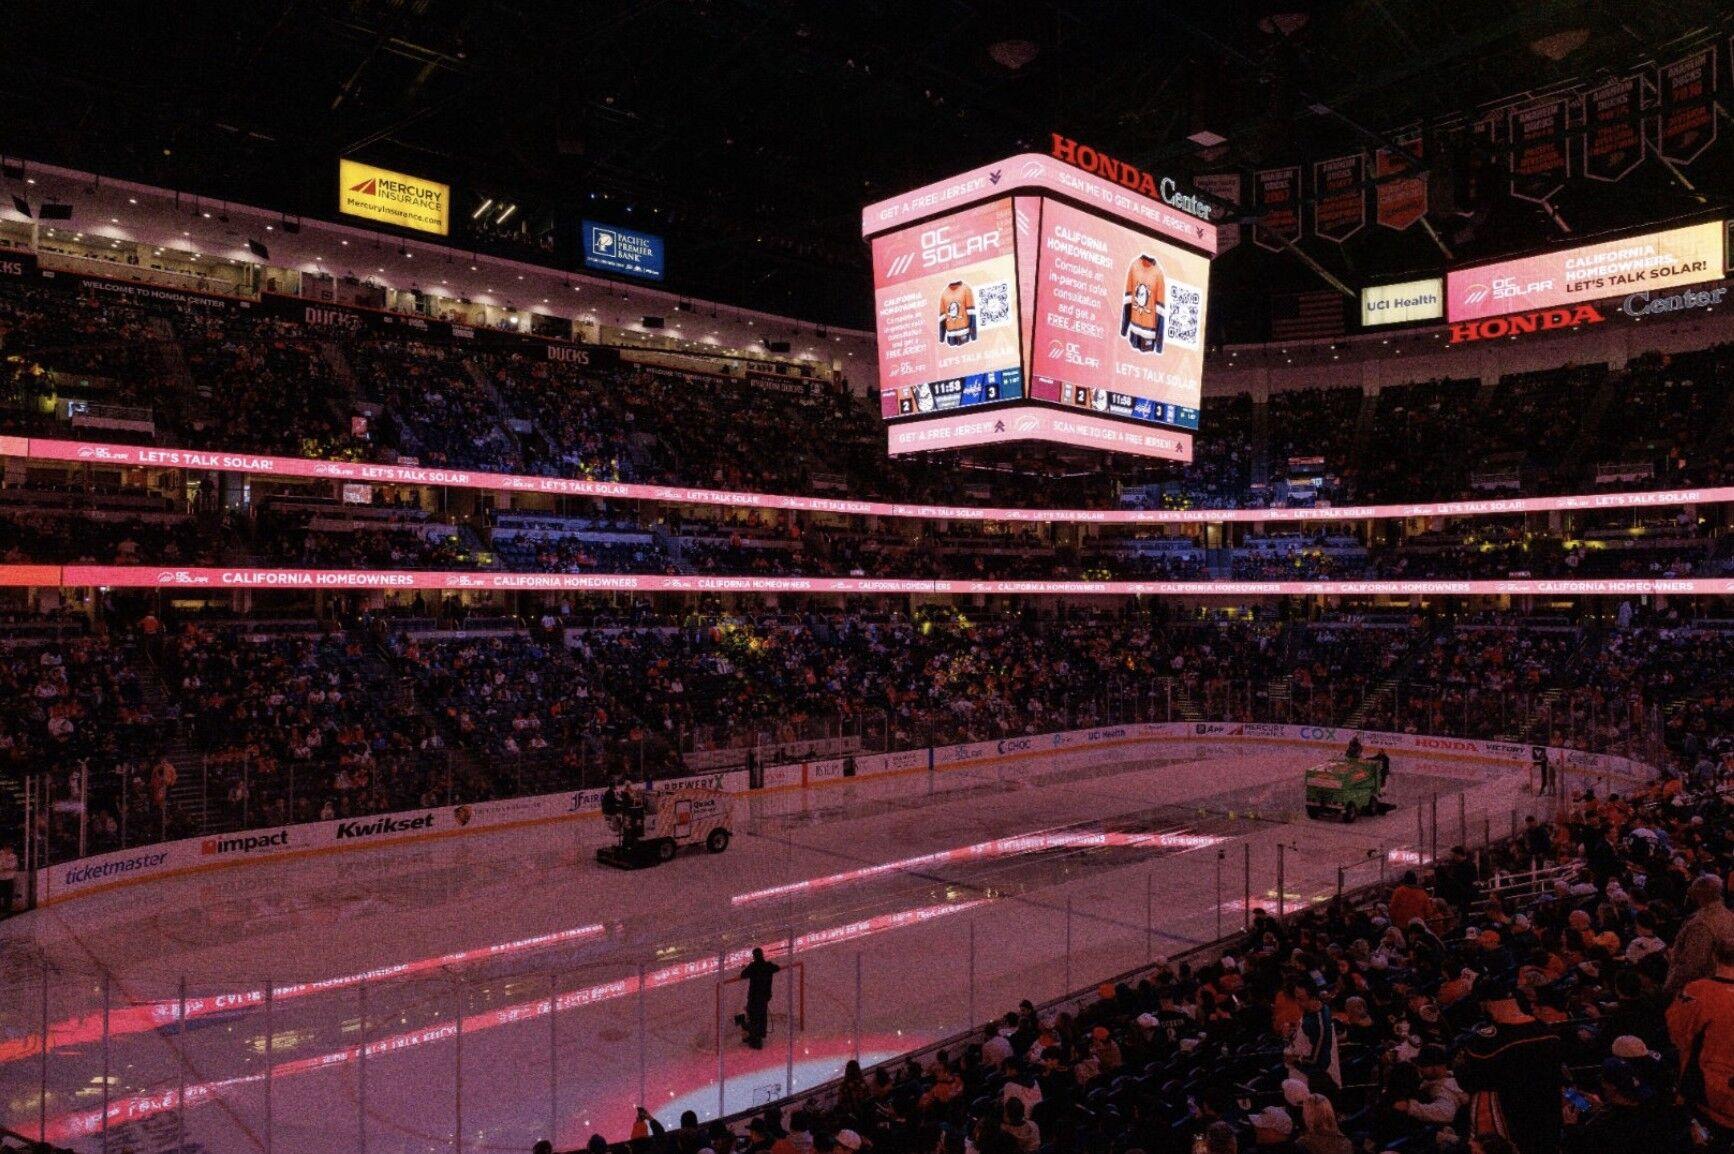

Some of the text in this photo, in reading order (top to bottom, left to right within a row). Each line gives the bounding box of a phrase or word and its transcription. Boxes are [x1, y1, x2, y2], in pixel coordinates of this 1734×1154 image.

[1052, 132, 1160, 200] HONDA
[1160, 177, 1212, 220] Center
[378, 178, 442, 202] MERCURY
[1058, 171, 1084, 191] SCAN
[1085, 180, 1101, 196] ME
[1101, 187, 1114, 202] TO
[1114, 194, 1131, 211] GET
[1131, 203, 1139, 214] A
[1140, 204, 1161, 222] FREE
[378, 188, 441, 212] INSURANCE
[880, 205, 900, 220] GET
[900, 202, 910, 213] A
[912, 194, 938, 211] FREE
[347, 197, 442, 226] MercuryInsurance.com
[618, 233, 650, 248] PACIFIC
[921, 226, 951, 249] OC
[1055, 226, 1108, 253] CALIFORNIA
[618, 242, 653, 257] PREMIER
[618, 250, 642, 262] BANK
[922, 231, 1000, 268] SOLAR
[1565, 244, 1655, 269] CALIFORNIA
[1493, 276, 1516, 290] OC
[1566, 261, 1707, 293] LET'S TALK SOLAR!
[82, 280, 225, 309] WELCOME TO HONDA CENTER
[1493, 279, 1553, 300] SOLAR
[1367, 294, 1437, 311] UCI Health
[1047, 312, 1069, 328] FREE
[1450, 287, 1728, 344] HONDA Center
[548, 344, 589, 365] DUCKS
[1065, 351, 1099, 368] SOLAR
[1115, 361, 1140, 379] LET'S
[1142, 368, 1164, 383] TALK
[988, 387, 996, 398] 3
[1078, 391, 1085, 402] 2
[903, 401, 910, 412] 2
[1156, 405, 1162, 417] 3
[899, 432, 917, 444] GET
[926, 428, 951, 440] FREE
[1053, 421, 1075, 433] SCAN
[1077, 425, 1088, 435] ME
[1088, 426, 1100, 437] TO
[1117, 431, 1124, 441] A
[1125, 433, 1143, 445] FREE
[139, 450, 274, 470] LET'S TALK SOLAR!
[361, 466, 470, 484] LET'S TALK SOLAR!
[540, 480, 629, 495] LET'S TALK SOLAR!
[686, 491, 709, 500] LET'S
[711, 493, 732, 502] TALK
[1595, 492, 1700, 506] LET'S TALK SOLAR!
[917, 505, 937, 515] LET'S
[1294, 508, 1375, 518] LET'S TALK SOLAR!
[1437, 501, 1525, 514] LET'S TALK SOLAR!
[1183, 512, 1201, 520] TALK
[222, 572, 414, 586] CALIFORNIA HOMEOWNERS
[493, 576, 638, 588] CALIFORNIA HOMEOWNERS
[699, 580, 811, 590] CALIFORNIA HOMEOWNERS
[1538, 582, 1694, 591] CALIFORNIA HOMEOWNERS
[998, 583, 1044, 591] CALIFORNIA
[1161, 584, 1212, 592] CALIFORNIA
[1341, 583, 1470, 592] CALIFORNIA HOMEOWNERS
[1245, 724, 1284, 733] MERCURY
[1301, 727, 1337, 740] COX
[1415, 738, 1479, 752] HONDA
[1485, 743, 1526, 754] VICTORY
[336, 812, 434, 840] Kwikset
[217, 830, 288, 855] impact
